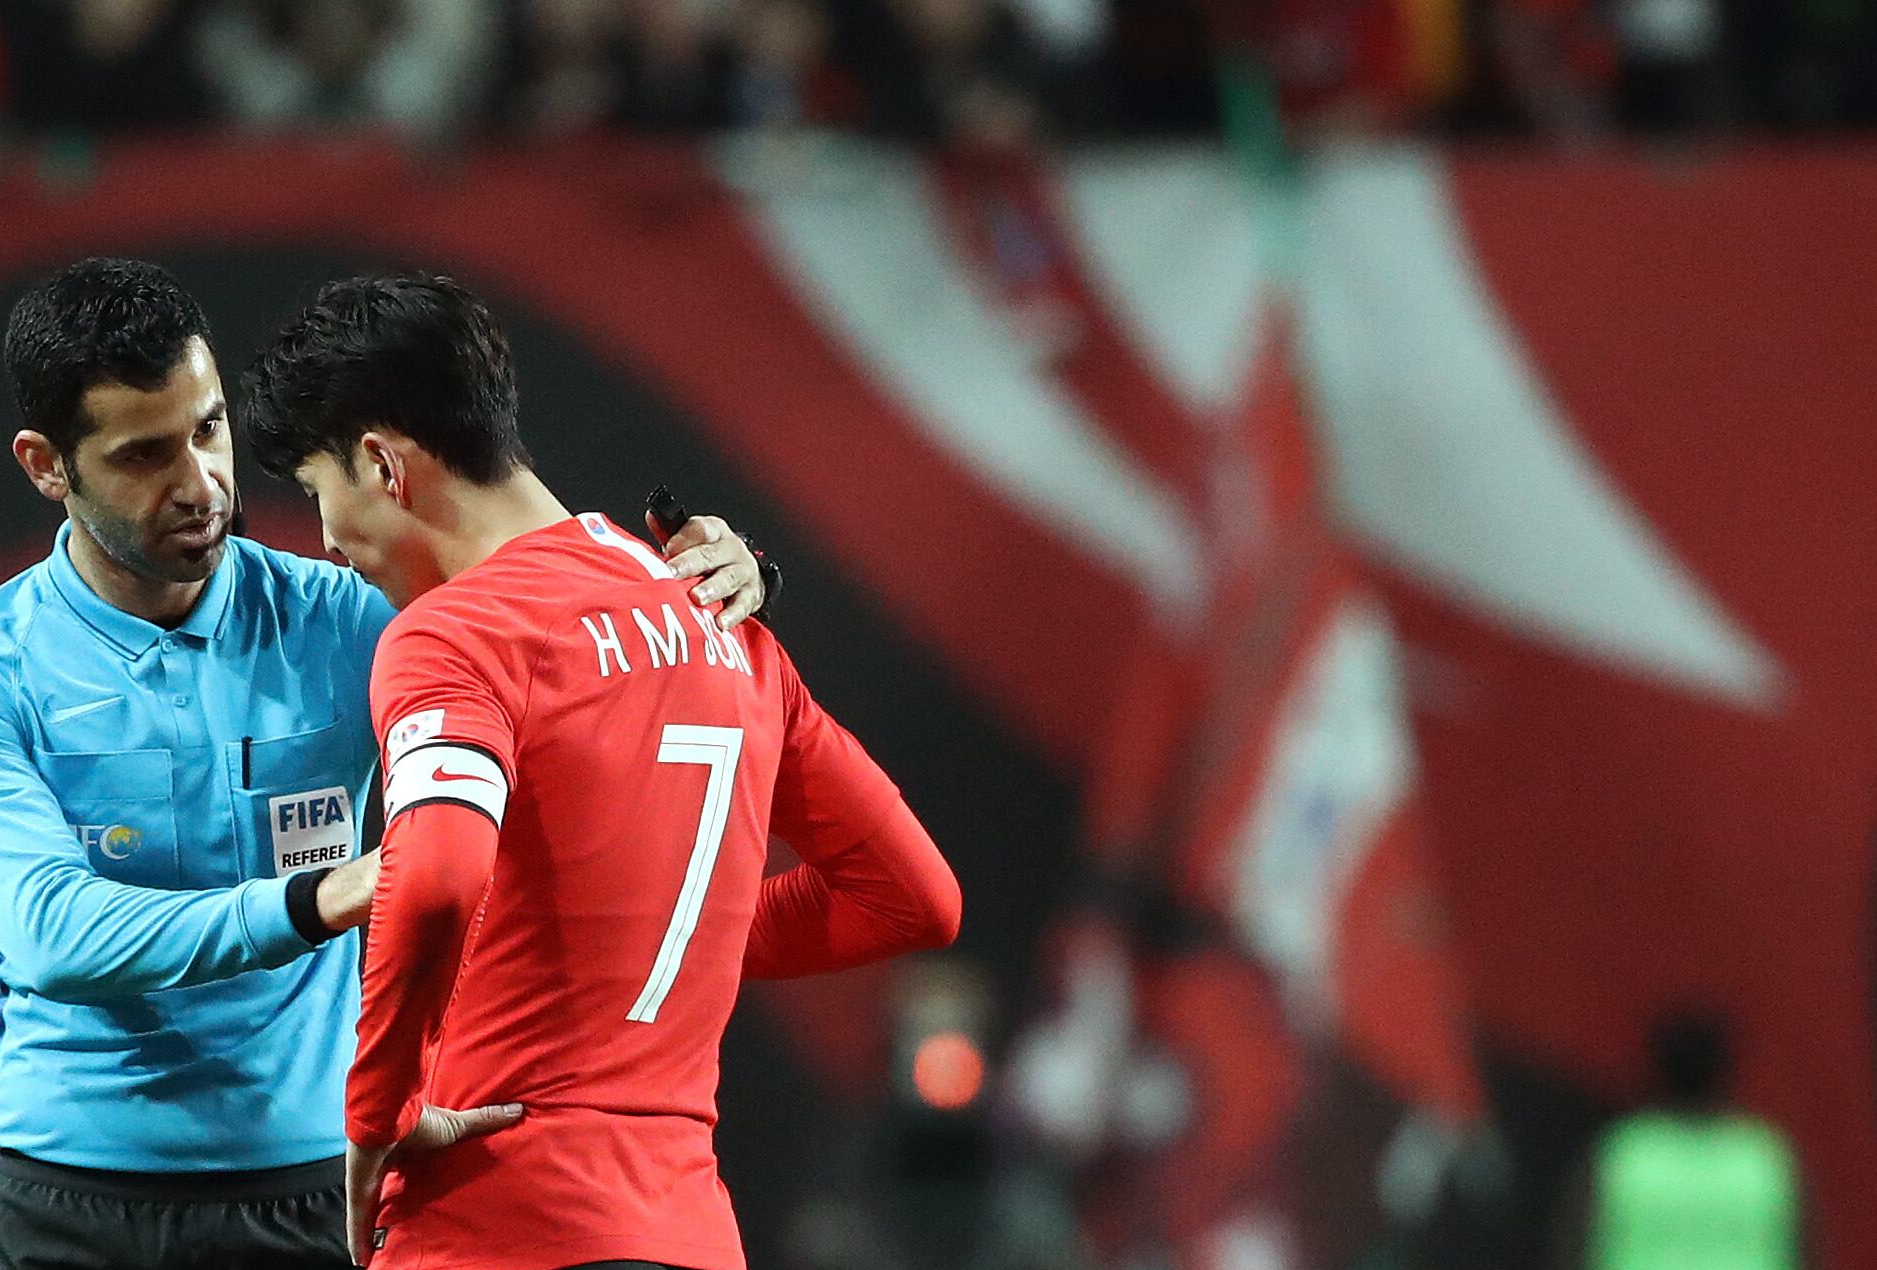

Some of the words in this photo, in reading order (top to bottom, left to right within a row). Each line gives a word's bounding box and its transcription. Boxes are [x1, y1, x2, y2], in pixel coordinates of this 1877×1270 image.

[580, 612, 632, 677] H
[631, 603, 690, 669] M
[278, 795, 345, 833] FIFA
[66, 824, 141, 861] FC
[282, 844, 347, 868] REFEREE
[625, 723, 744, 1024] 7
